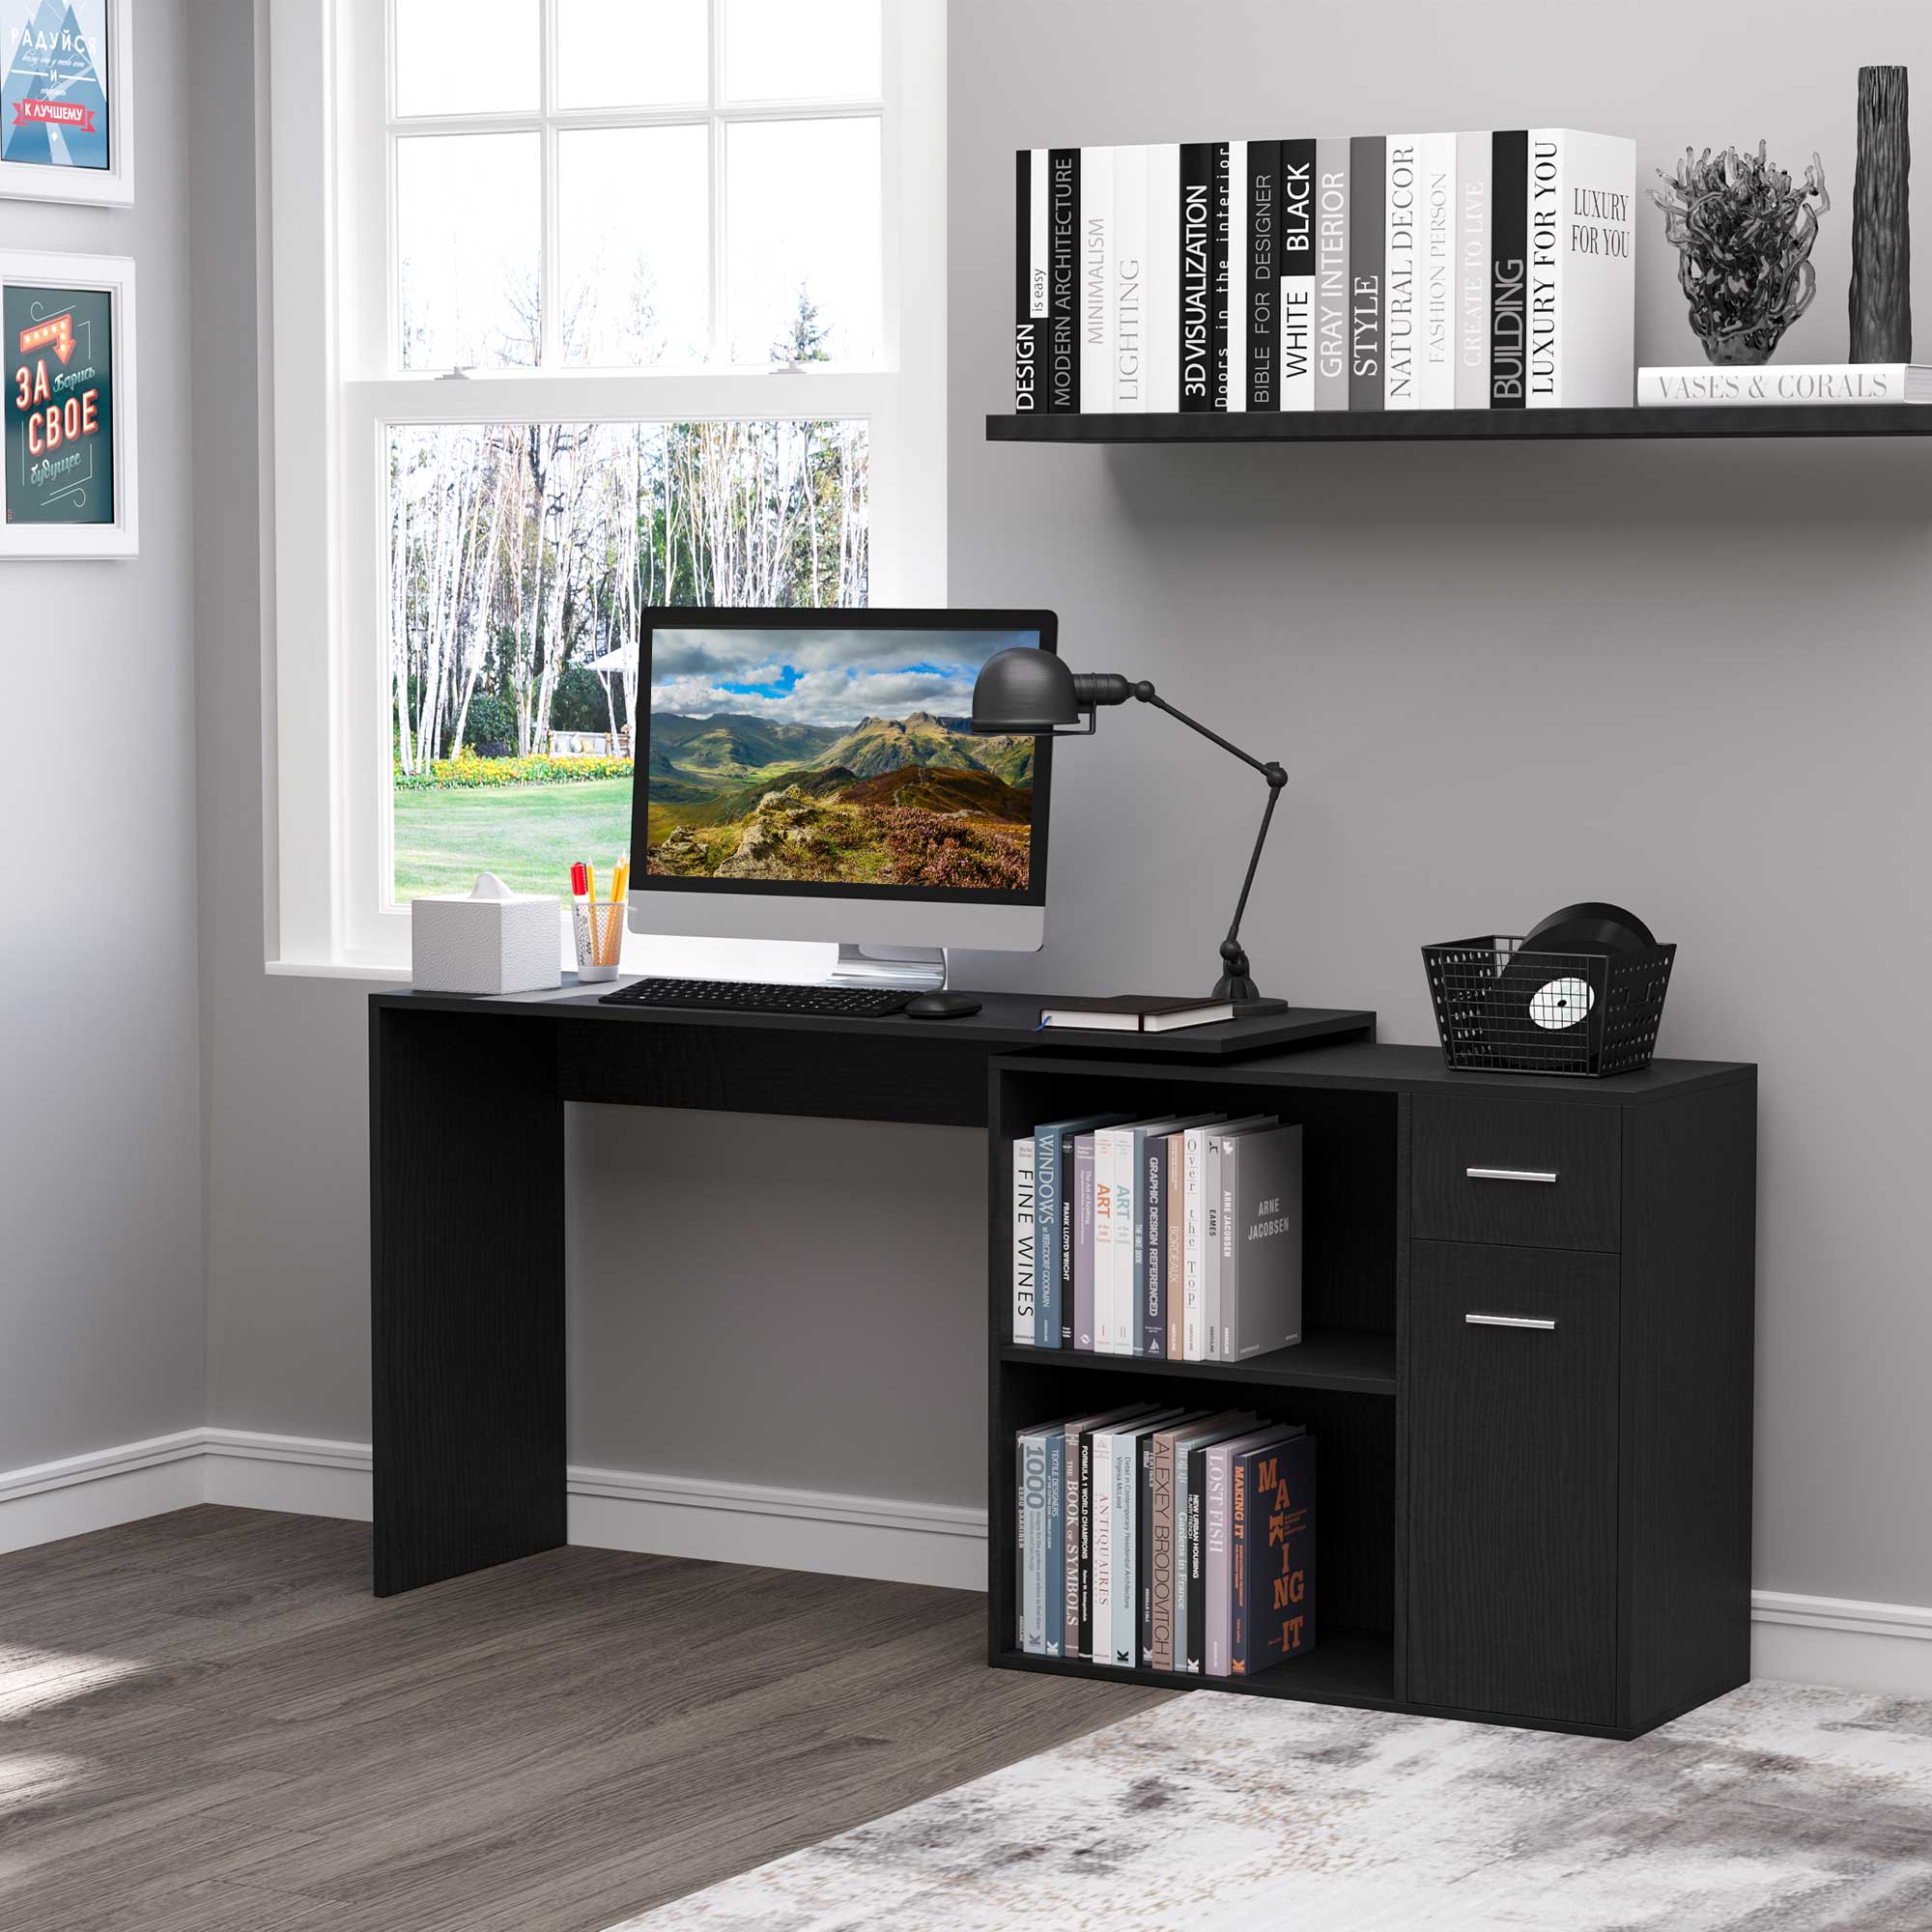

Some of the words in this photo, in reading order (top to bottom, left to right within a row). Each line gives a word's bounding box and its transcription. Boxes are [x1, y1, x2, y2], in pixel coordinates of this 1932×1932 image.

[11, 27, 97, 55] РАДУЙСЯ
[50, 71, 58, 82] И
[24, 103, 32, 117] К
[33, 104, 84, 122] ЛУЧШЕМУ
[1217, 148, 1230, 242] interior
[1534, 140, 1558, 200] YOU
[1286, 162, 1310, 251] BLACK
[1391, 146, 1414, 251] DECOR
[1430, 172, 1447, 258] PERSON
[1464, 182, 1485, 233] LIVE
[1573, 187, 1630, 222] LUXURY
[1055, 157, 1072, 310] ARCHITECTURE
[1256, 174, 1272, 280] DESIGNER
[1321, 171, 1345, 297] INTERIOR
[1533, 208, 1557, 270] FOR
[1571, 224, 1600, 253] FOR
[1603, 229, 1631, 259] YOU
[1088, 218, 1105, 345] MINIMALISM
[1184, 185, 1208, 360] VISUALIZATION
[1216, 259, 1229, 294] the
[1464, 241, 1484, 271] TO
[1032, 302, 1043, 312] is
[1034, 269, 1047, 300] easy
[1119, 259, 1140, 402] LIGHTING
[1255, 292, 1270, 334] FOR
[1286, 291, 1309, 379] WHITE
[1321, 299, 1344, 379] GRAY
[1353, 274, 1379, 377] STYLE
[1390, 260, 1413, 399] NATURAL
[1429, 265, 1446, 363] FASHION
[1463, 277, 1483, 368] CREATE
[1493, 259, 1523, 399] BUILDING
[1531, 276, 1556, 395] LUXURY
[15, 358, 51, 411] ЗА
[53, 366, 96, 394] Борись
[1016, 324, 1035, 411] DESIGN
[1054, 316, 1071, 407] MODERN
[1184, 363, 1207, 398] 3D
[1254, 346, 1270, 403] BIBLE
[1659, 374, 1740, 400] VASES
[1747, 374, 1769, 399] &
[1777, 372, 1888, 399] CORALS
[28, 388, 99, 456] СВОЕ
[30, 452, 81, 487] будущее
[1017, 1169, 1034, 1224] FINE
[1037, 1134, 1055, 1225] WINDOWS
[1096, 1183, 1111, 1219] ART
[1117, 1184, 1130, 1220] ART
[1150, 1156, 1158, 1205] GRAPHIC
[1223, 1190, 1232, 1212] ARNE
[1150, 1207, 1158, 1245] DESIGN
[1208, 1209, 1217, 1237] EAMES
[1247, 1217, 1290, 1241] JACOBSEN
[1258, 1198, 1281, 1217] ARNE
[1169, 1225, 1179, 1284] BORDEAUX
[1223, 1215, 1232, 1258] JACOBSEN
[1017, 1236, 1034, 1317] WINES
[1042, 1270, 1051, 1308] GOODMAN
[1150, 1247, 1158, 1317] REFERENCED
[1026, 1445, 1045, 1510] 1000
[1066, 1479, 1079, 1527] BOOK
[1154, 1440, 1170, 1520] ALEXEY
[1208, 1455, 1224, 1506] LOST
[1234, 1465, 1245, 1521] MAKING
[1097, 1492, 1109, 1605] ANTIQUAIRES
[1178, 1512, 1187, 1556] Gardens
[1208, 1508, 1224, 1553] FISH
[1234, 1524, 1245, 1539] IT
[1066, 1544, 1079, 1626] SYMBOLS
[1154, 1525, 1170, 1655] BRODOVITCH
[1178, 1559, 1187, 1570] in
[1178, 1574, 1187, 1610] France
[1282, 1615, 1303, 1654] IT
